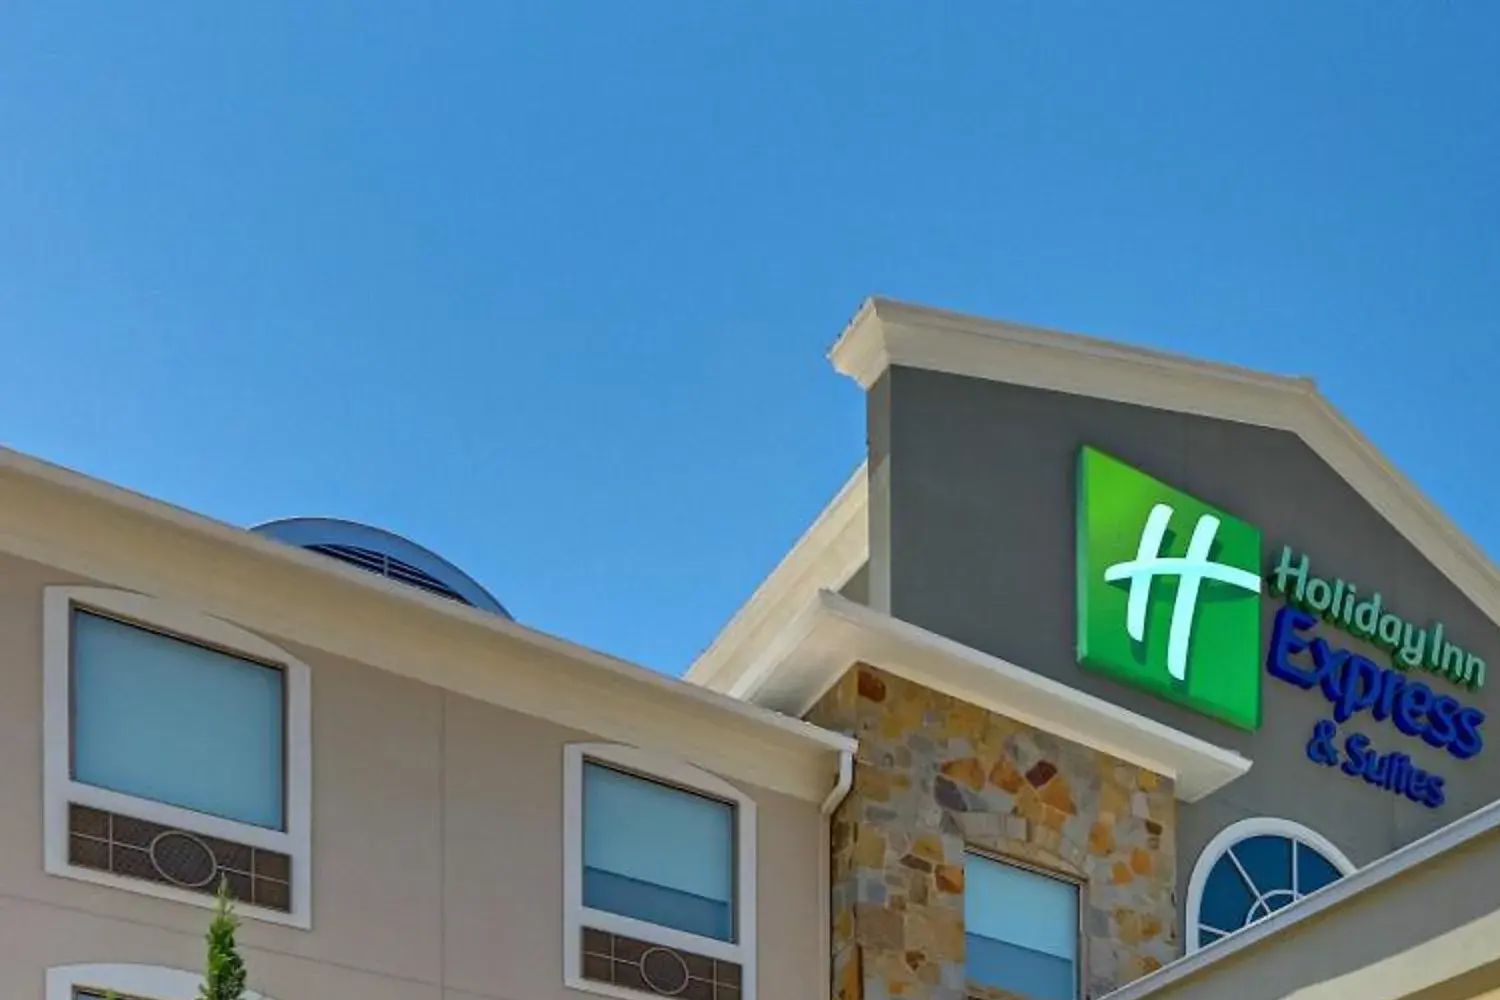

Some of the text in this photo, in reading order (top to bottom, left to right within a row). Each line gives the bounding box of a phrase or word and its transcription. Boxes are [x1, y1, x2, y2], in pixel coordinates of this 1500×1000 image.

[1104, 503, 1261, 681] H
[1272, 545, 1486, 690] Holiday Inn
[1267, 605, 1486, 760] Express
[1306, 720, 1446, 808] & Suites
